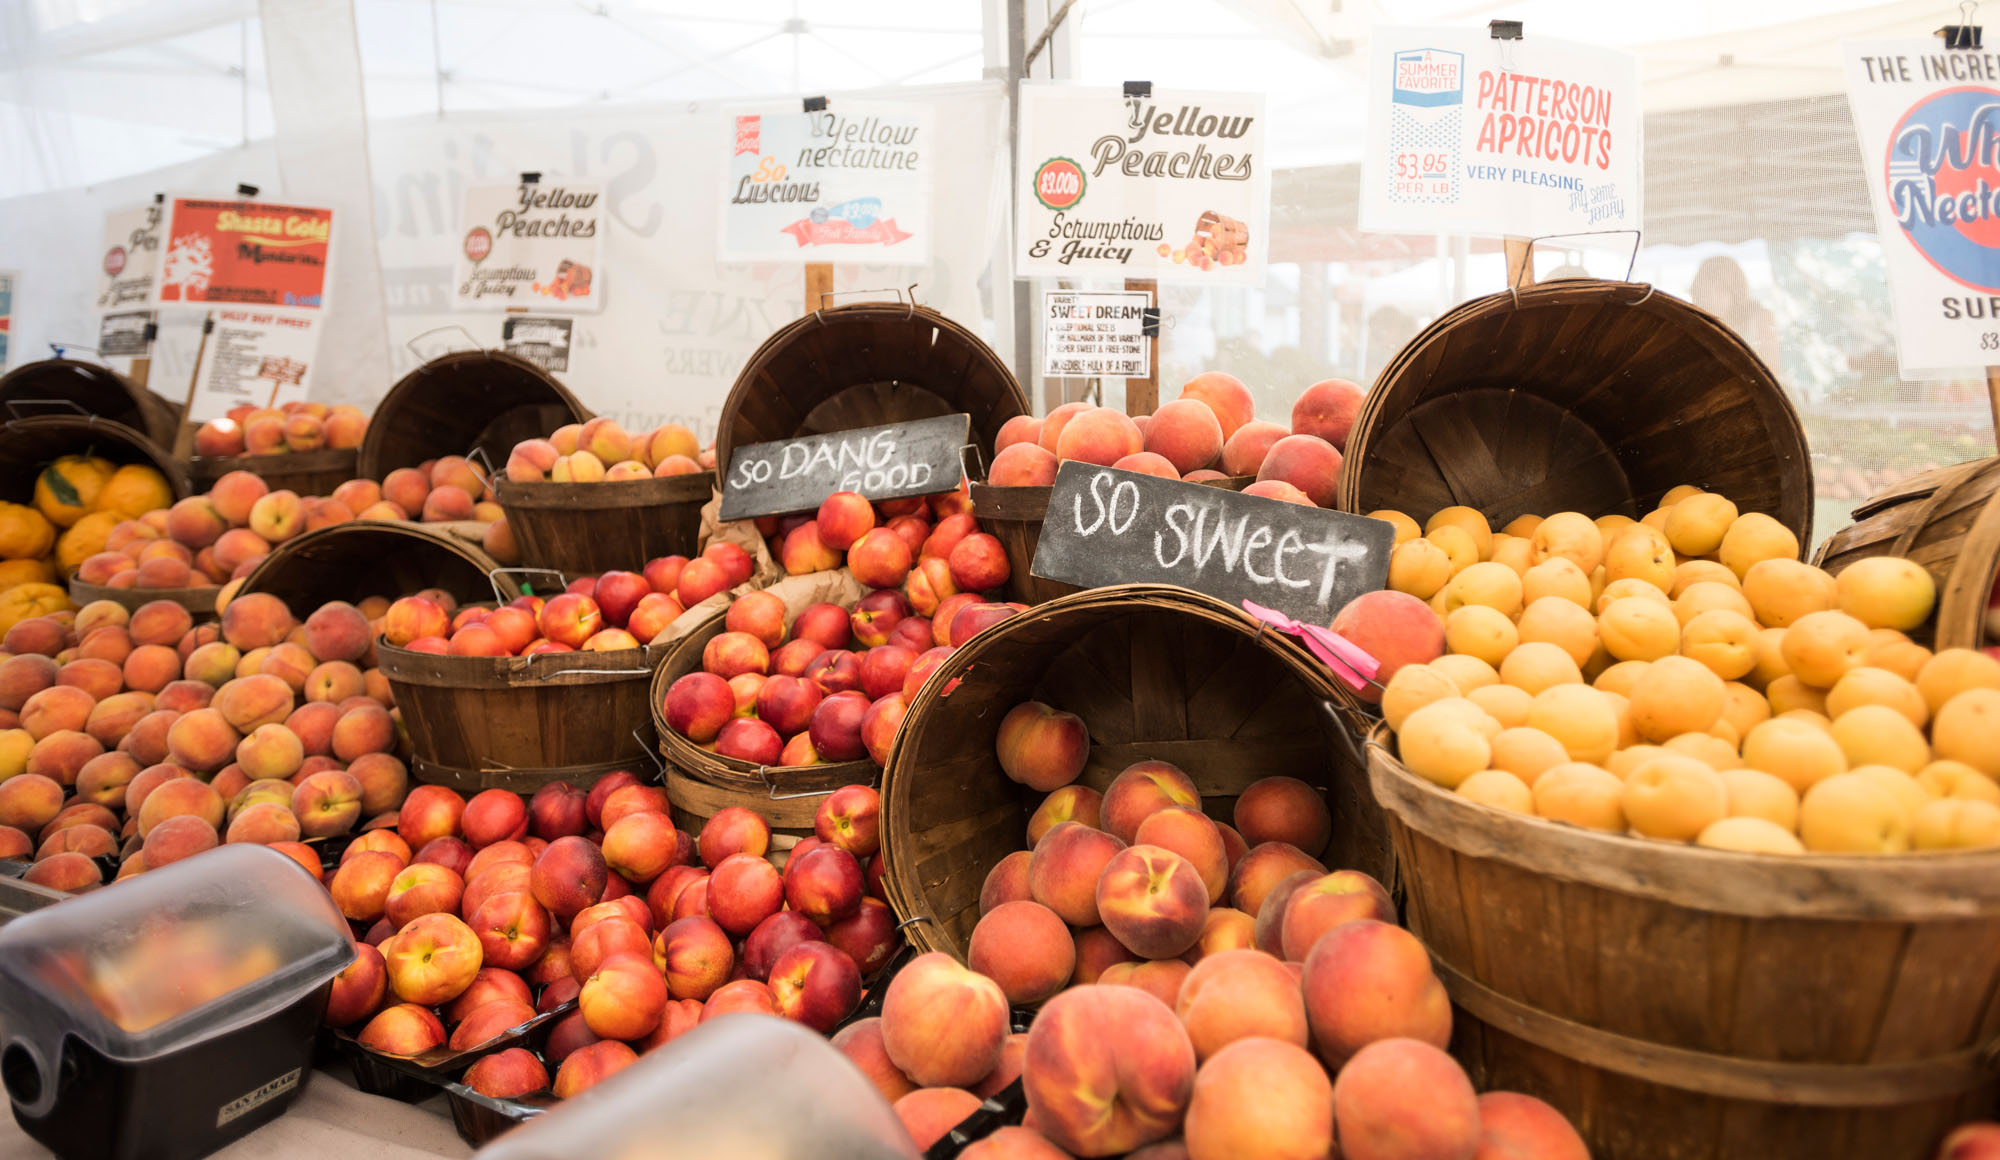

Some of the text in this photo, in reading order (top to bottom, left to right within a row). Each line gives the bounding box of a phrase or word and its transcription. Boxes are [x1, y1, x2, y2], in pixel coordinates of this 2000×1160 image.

[1398, 62, 1457, 77] SUMMER
[1423, 50, 1433, 62] A
[1861, 53, 2000, 83] THE INCRE
[1398, 76, 1457, 90] FAVORITE
[1477, 69, 1612, 129] PATTERSON
[823, 112, 920, 150] Yellow
[1125, 99, 1254, 144] Yellow
[1476, 112, 1612, 171] APRICOTS
[752, 155, 788, 183] So
[796, 143, 920, 171] nectarine
[1090, 134, 1253, 181] Peaches
[1396, 153, 1448, 181] $3.95
[731, 174, 821, 205] Luscious
[1396, 182, 1449, 195] PER LB
[1466, 164, 1584, 192] VERY PLEASING
[517, 185, 599, 215] Yellow
[215, 210, 329, 239] Shasta Gold
[495, 208, 596, 239] Peaches
[1048, 211, 1164, 246] Scrumptious
[1028, 239, 1134, 266] & Juicy
[1050, 305, 1142, 320] SWEET DREAM
[1941, 296, 2000, 320] SUP
[730, 429, 897, 490] SO DANG
[839, 462, 933, 494] GOOD
[1073, 472, 1141, 537] SO
